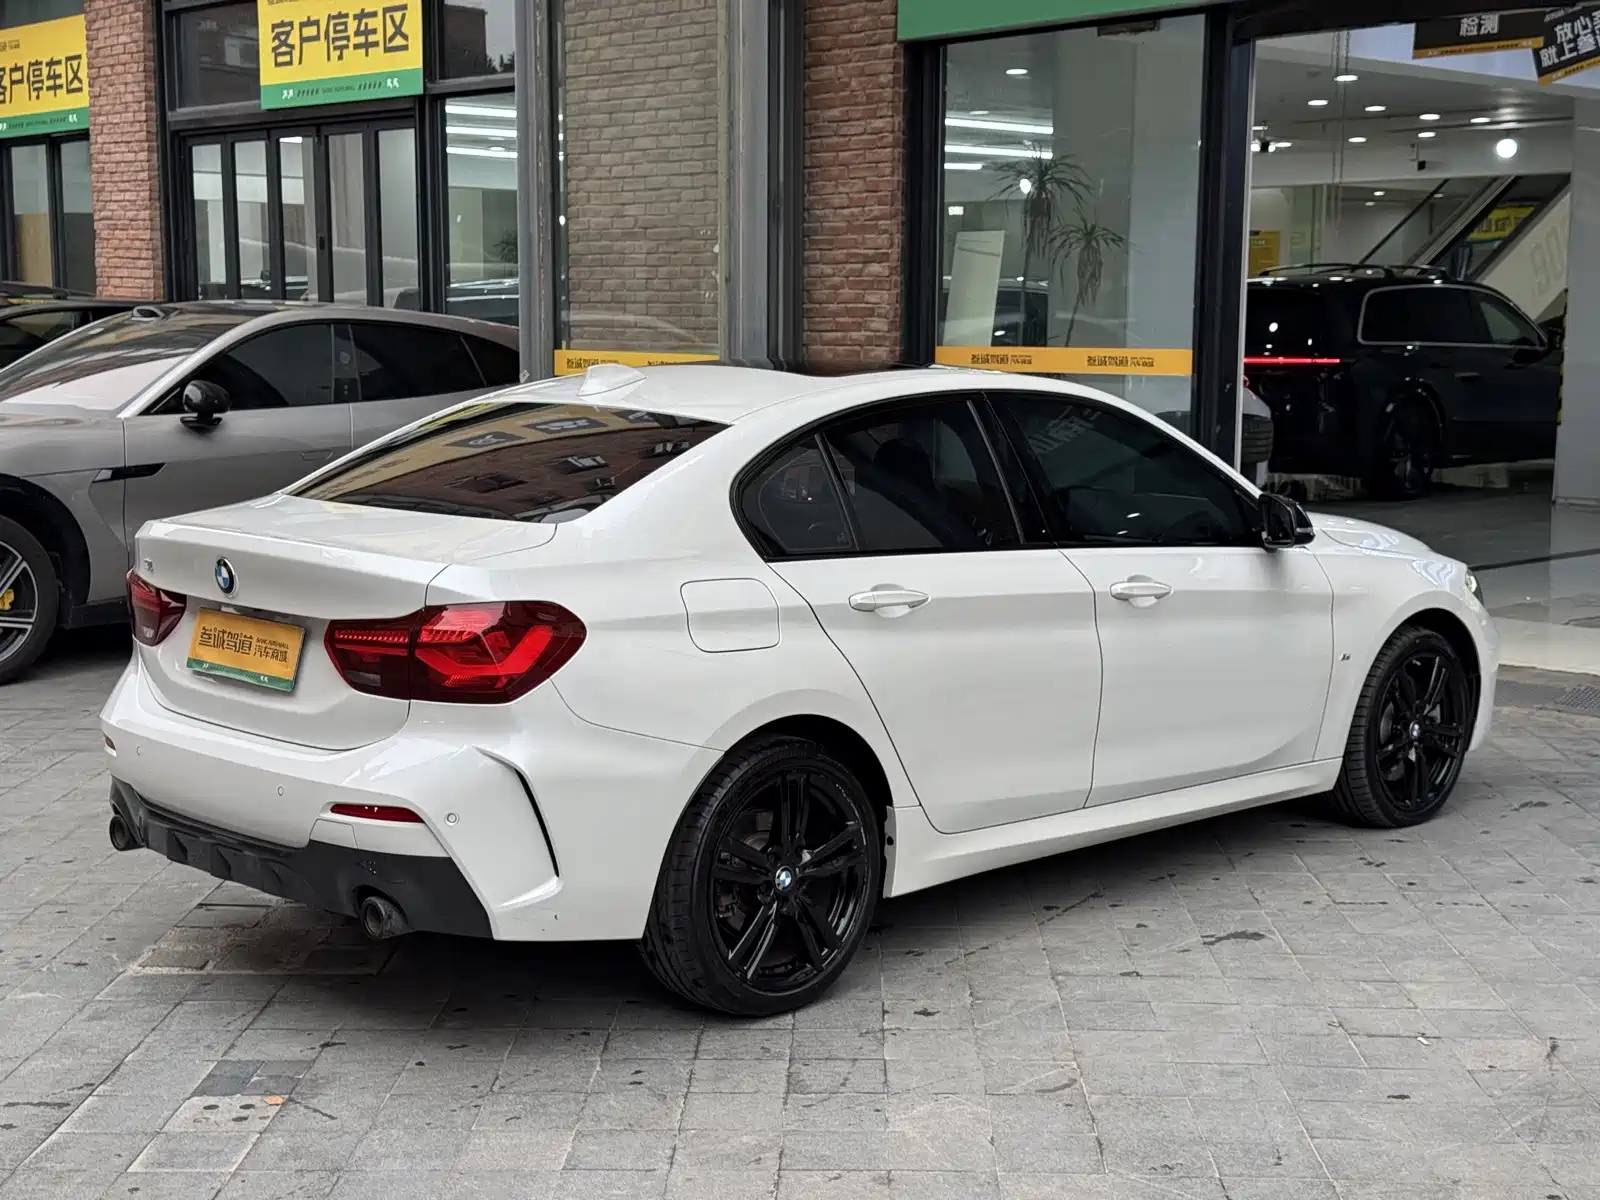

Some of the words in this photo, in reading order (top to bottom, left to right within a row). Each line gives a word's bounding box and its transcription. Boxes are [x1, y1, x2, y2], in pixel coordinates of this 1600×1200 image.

[271, 3, 409, 68] 客户停车区
[1460, 13, 1500, 36] 检测
[1539, 33, 1600, 67] 就上叁
